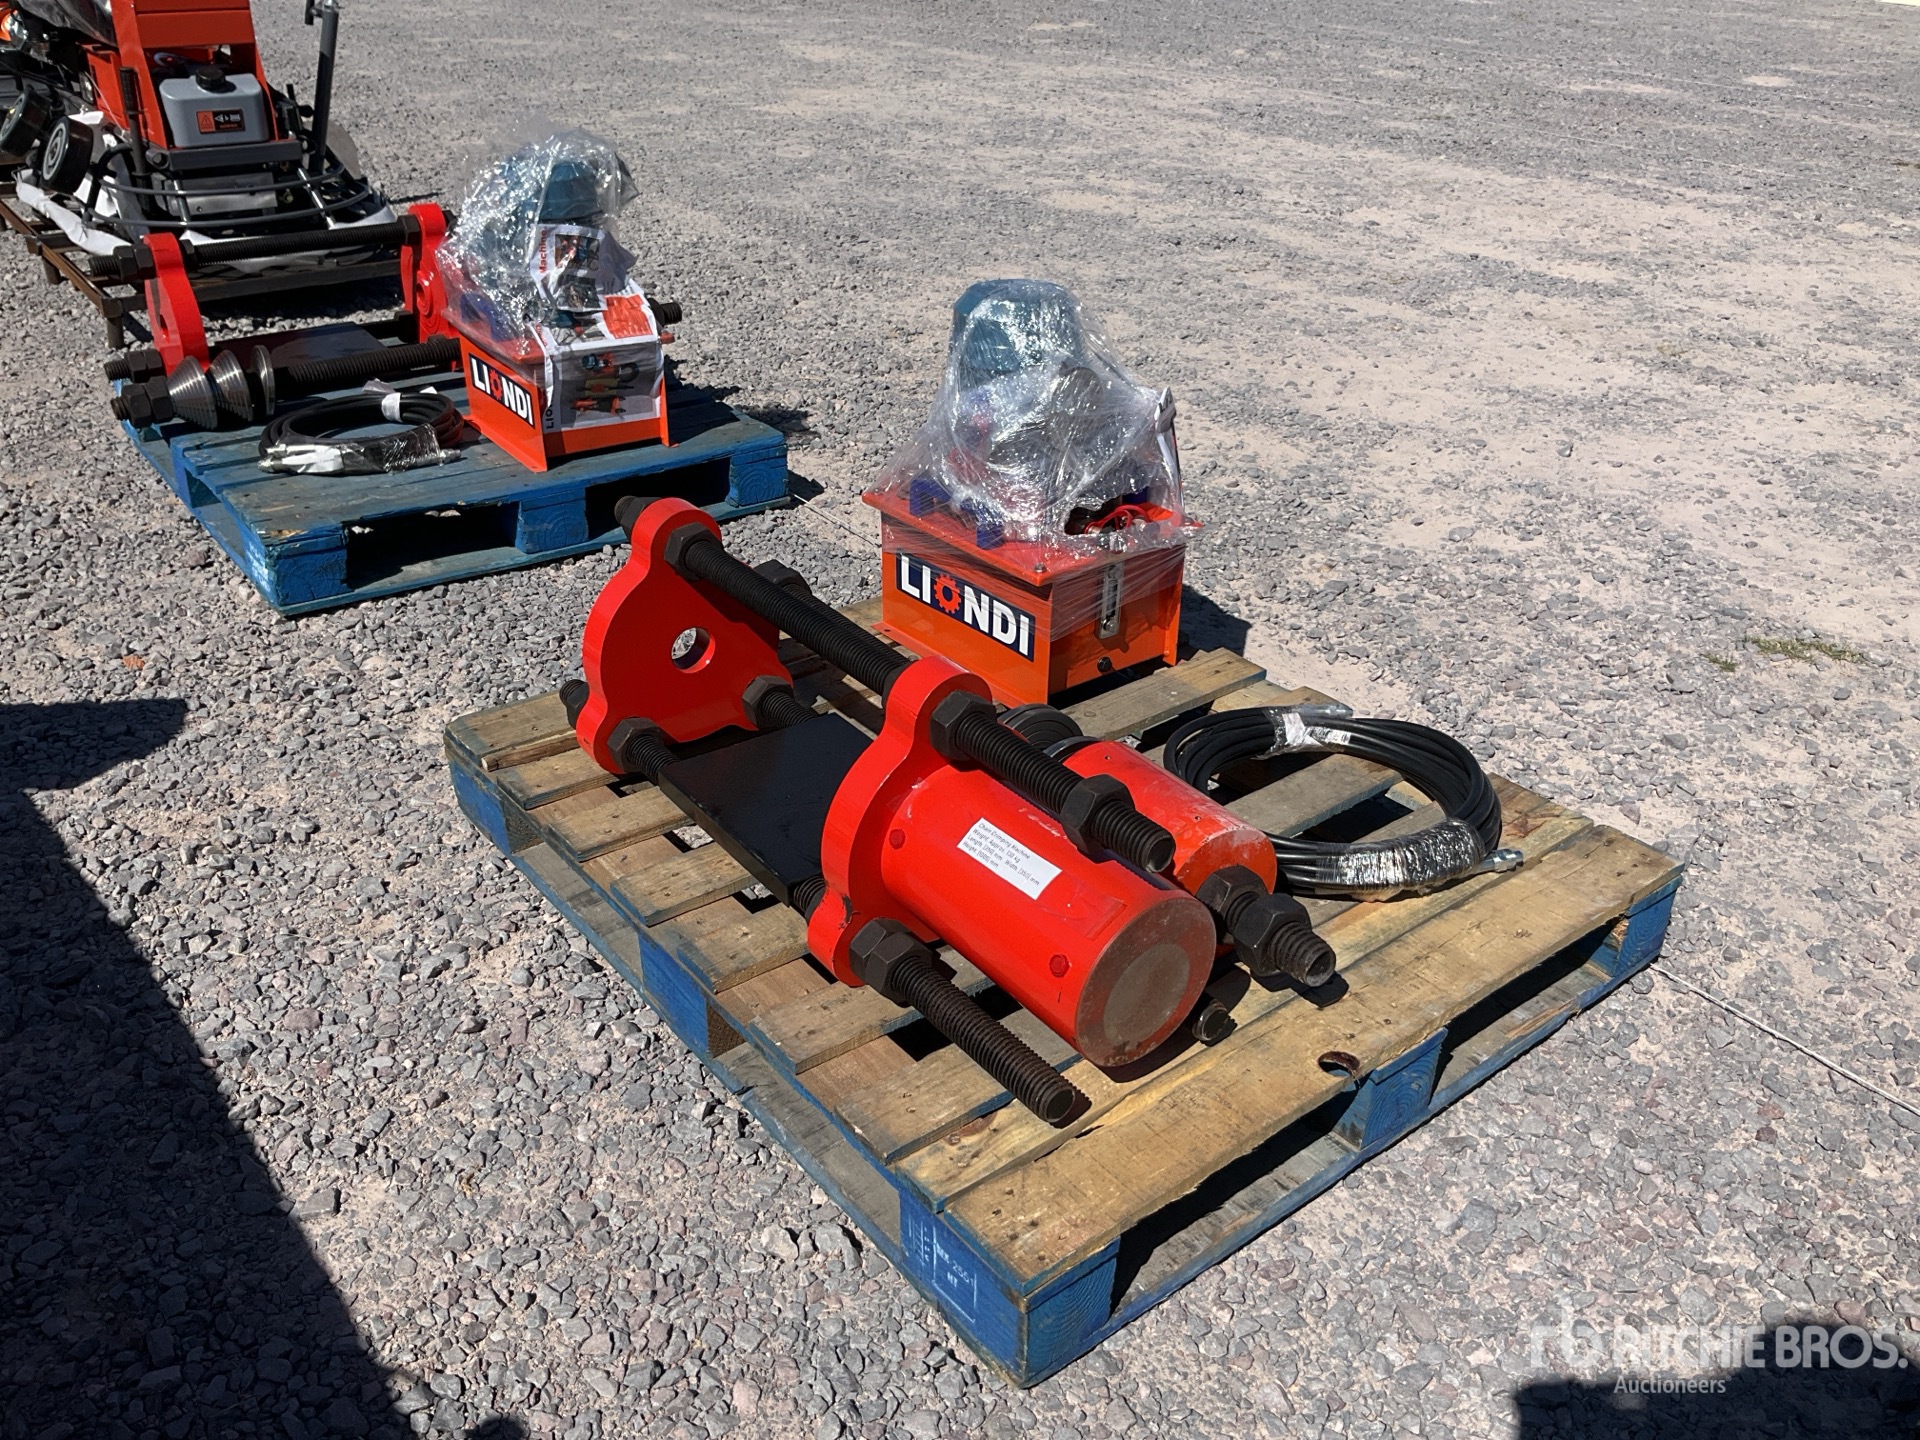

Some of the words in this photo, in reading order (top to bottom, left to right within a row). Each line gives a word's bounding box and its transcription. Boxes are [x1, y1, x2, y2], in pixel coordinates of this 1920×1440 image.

[471, 357, 534, 426] LIONDI
[900, 555, 1031, 656] LIONDI
[978, 822, 992, 833] Chain
[990, 830, 1012, 848] Crimping
[1010, 844, 1031, 859] Machine
